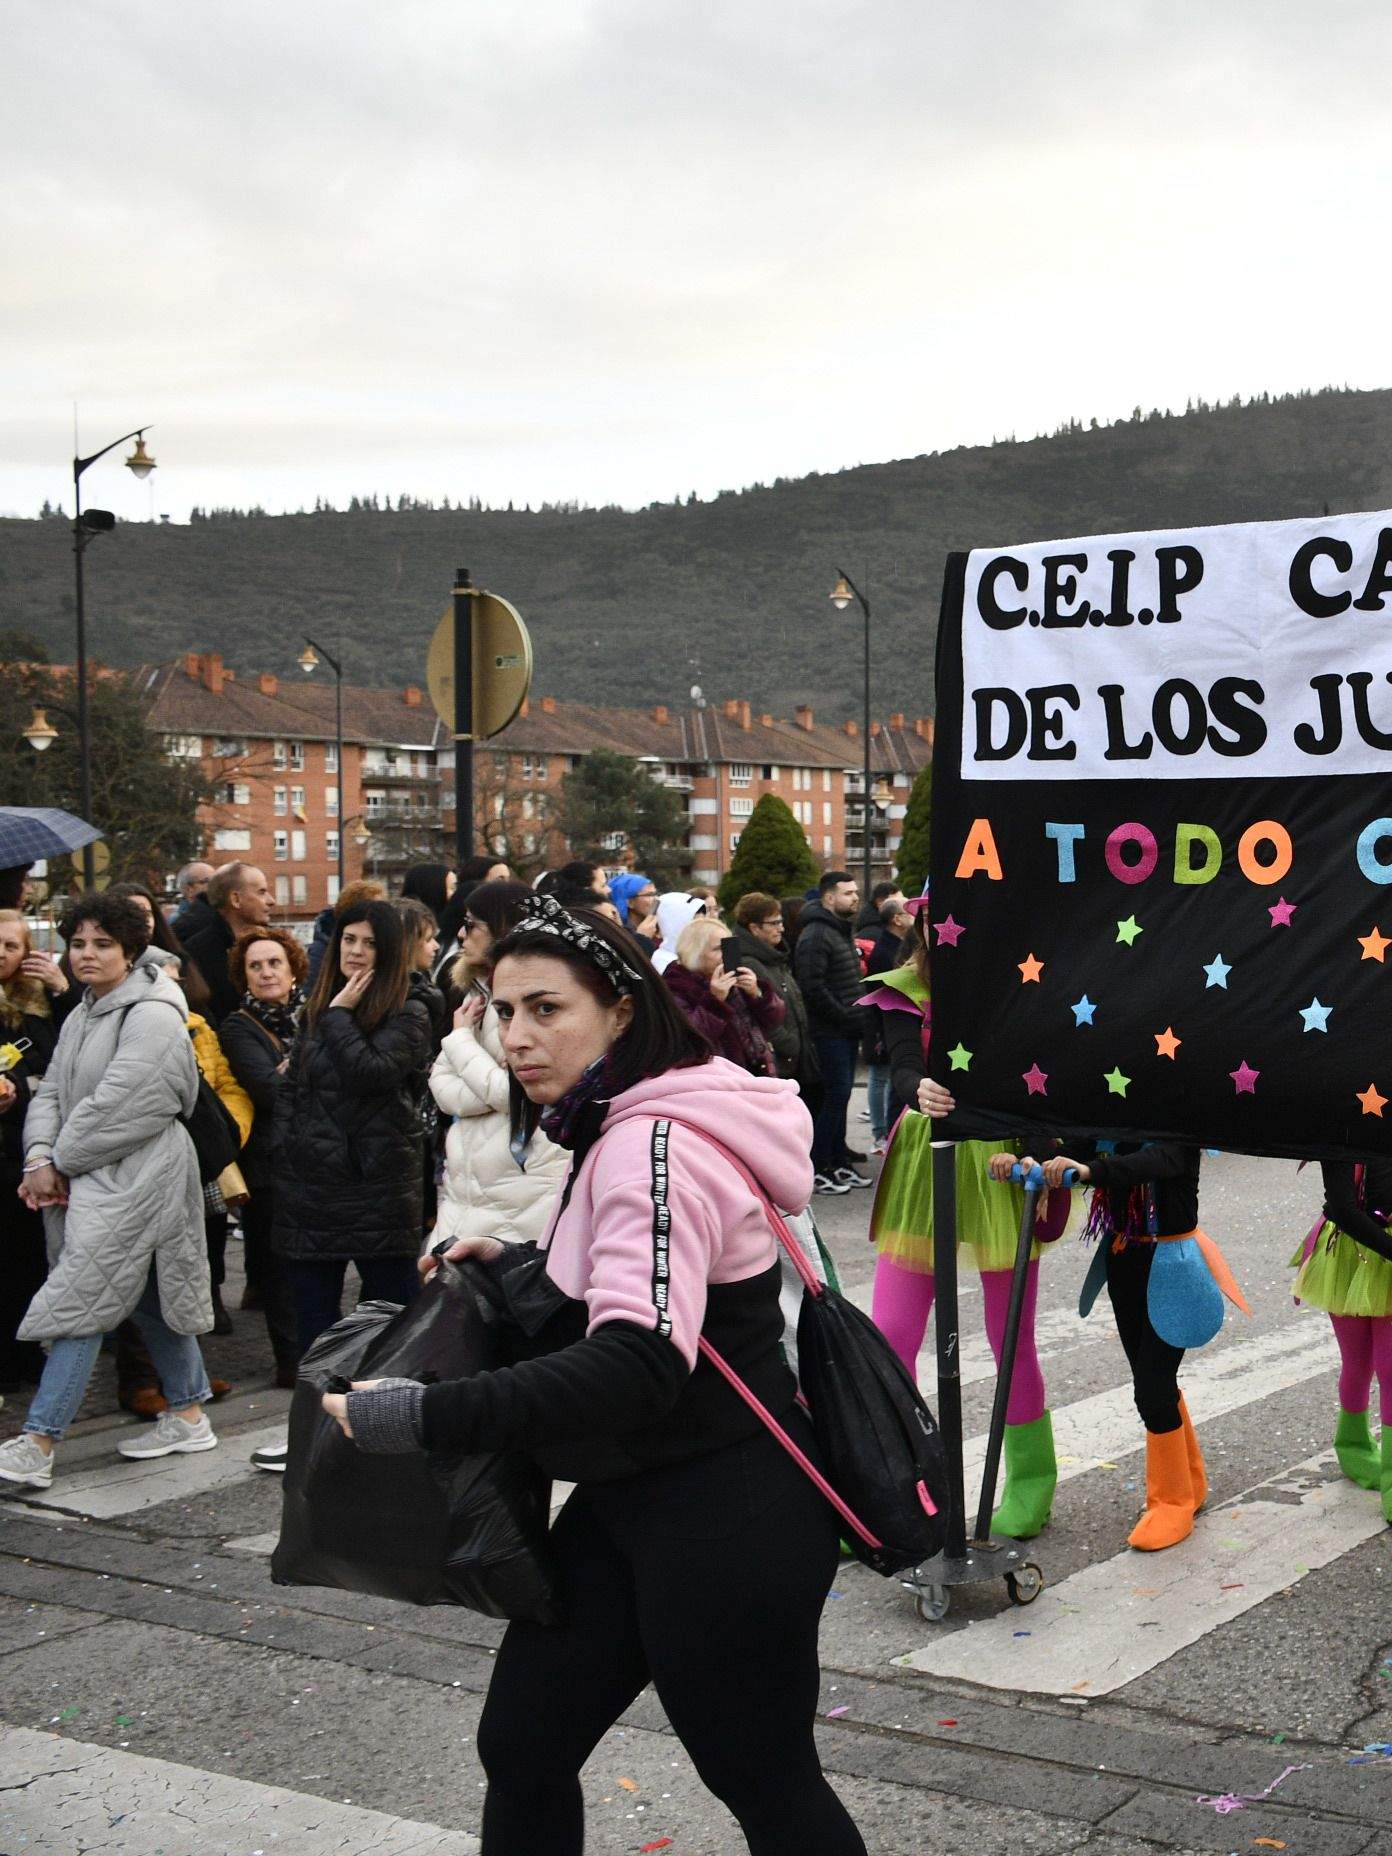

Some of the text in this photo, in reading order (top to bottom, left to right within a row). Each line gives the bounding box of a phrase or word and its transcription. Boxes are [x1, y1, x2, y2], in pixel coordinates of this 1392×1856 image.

[977, 546, 1203, 630] C.E.I.P
[972, 684, 1080, 761] DE
[1098, 677, 1267, 760] LOS
[955, 819, 1003, 880] A
[1046, 820, 1292, 885] TODO
[653, 1136, 667, 1160] READY
[654, 1161, 667, 1174] FOR
[653, 1176, 668, 1204] WINTER
[656, 1205, 670, 1230] READY
[655, 1250, 669, 1277] WINTER
[654, 1283, 668, 1308] READY
